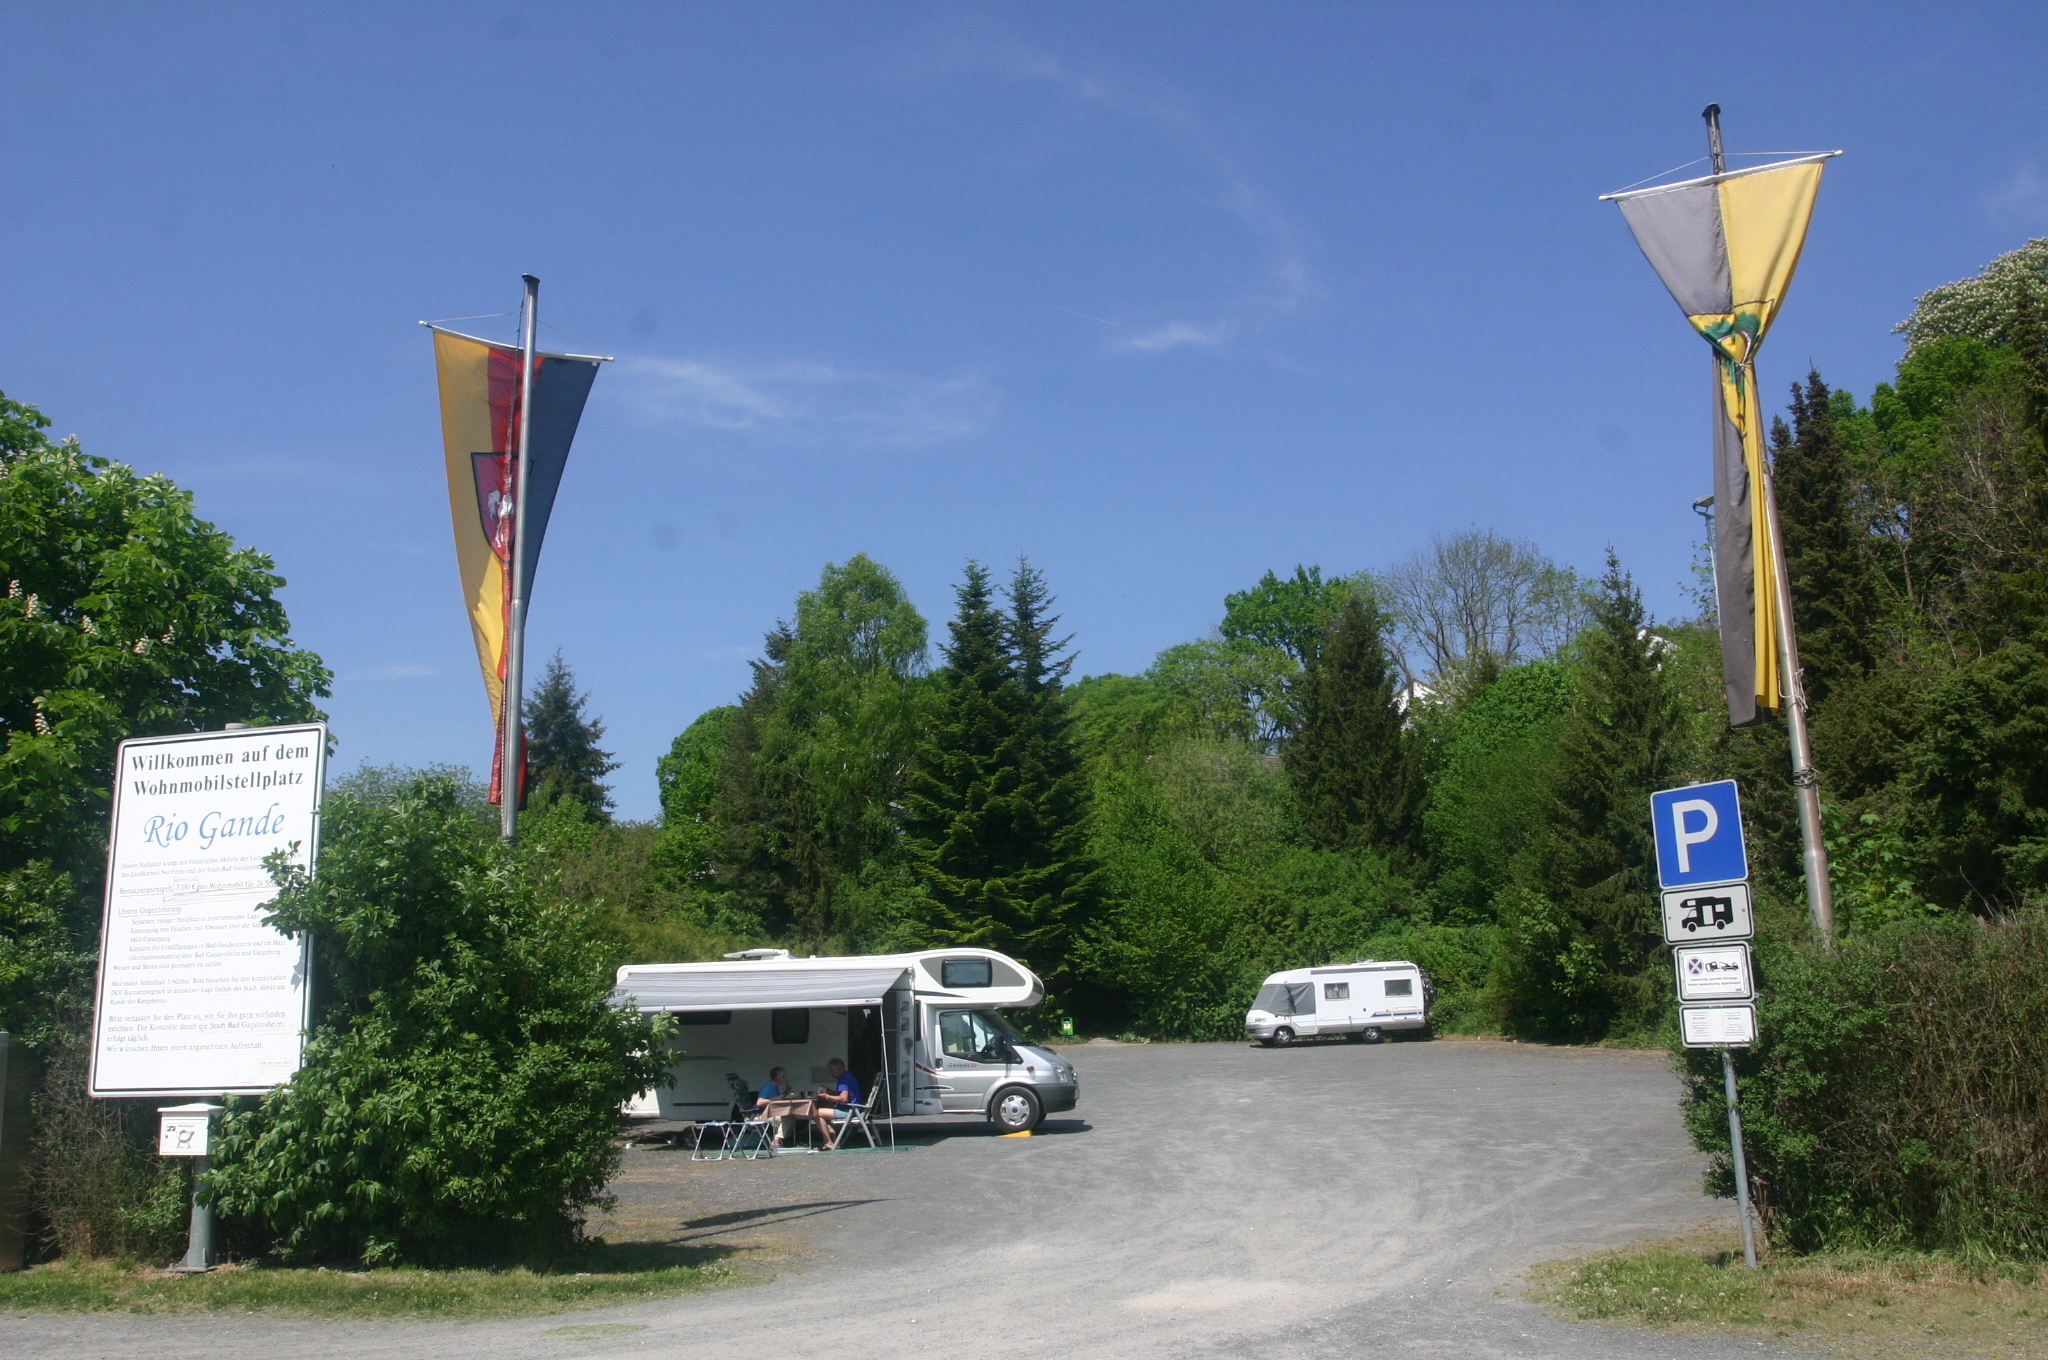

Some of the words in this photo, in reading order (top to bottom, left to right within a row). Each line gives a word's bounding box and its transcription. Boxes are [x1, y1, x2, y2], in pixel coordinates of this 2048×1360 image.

[132, 752, 234, 771] Willkommen
[241, 745, 270, 763] auf
[275, 744, 309, 760] dem
[134, 770, 304, 796] Wohnmobilstellplatz
[143, 812, 189, 848] Rio
[199, 802, 285, 850] Gande
[1672, 798, 1719, 873] P
[215, 1011, 226, 1019] Sie
[227, 1021, 240, 1029] Bad
